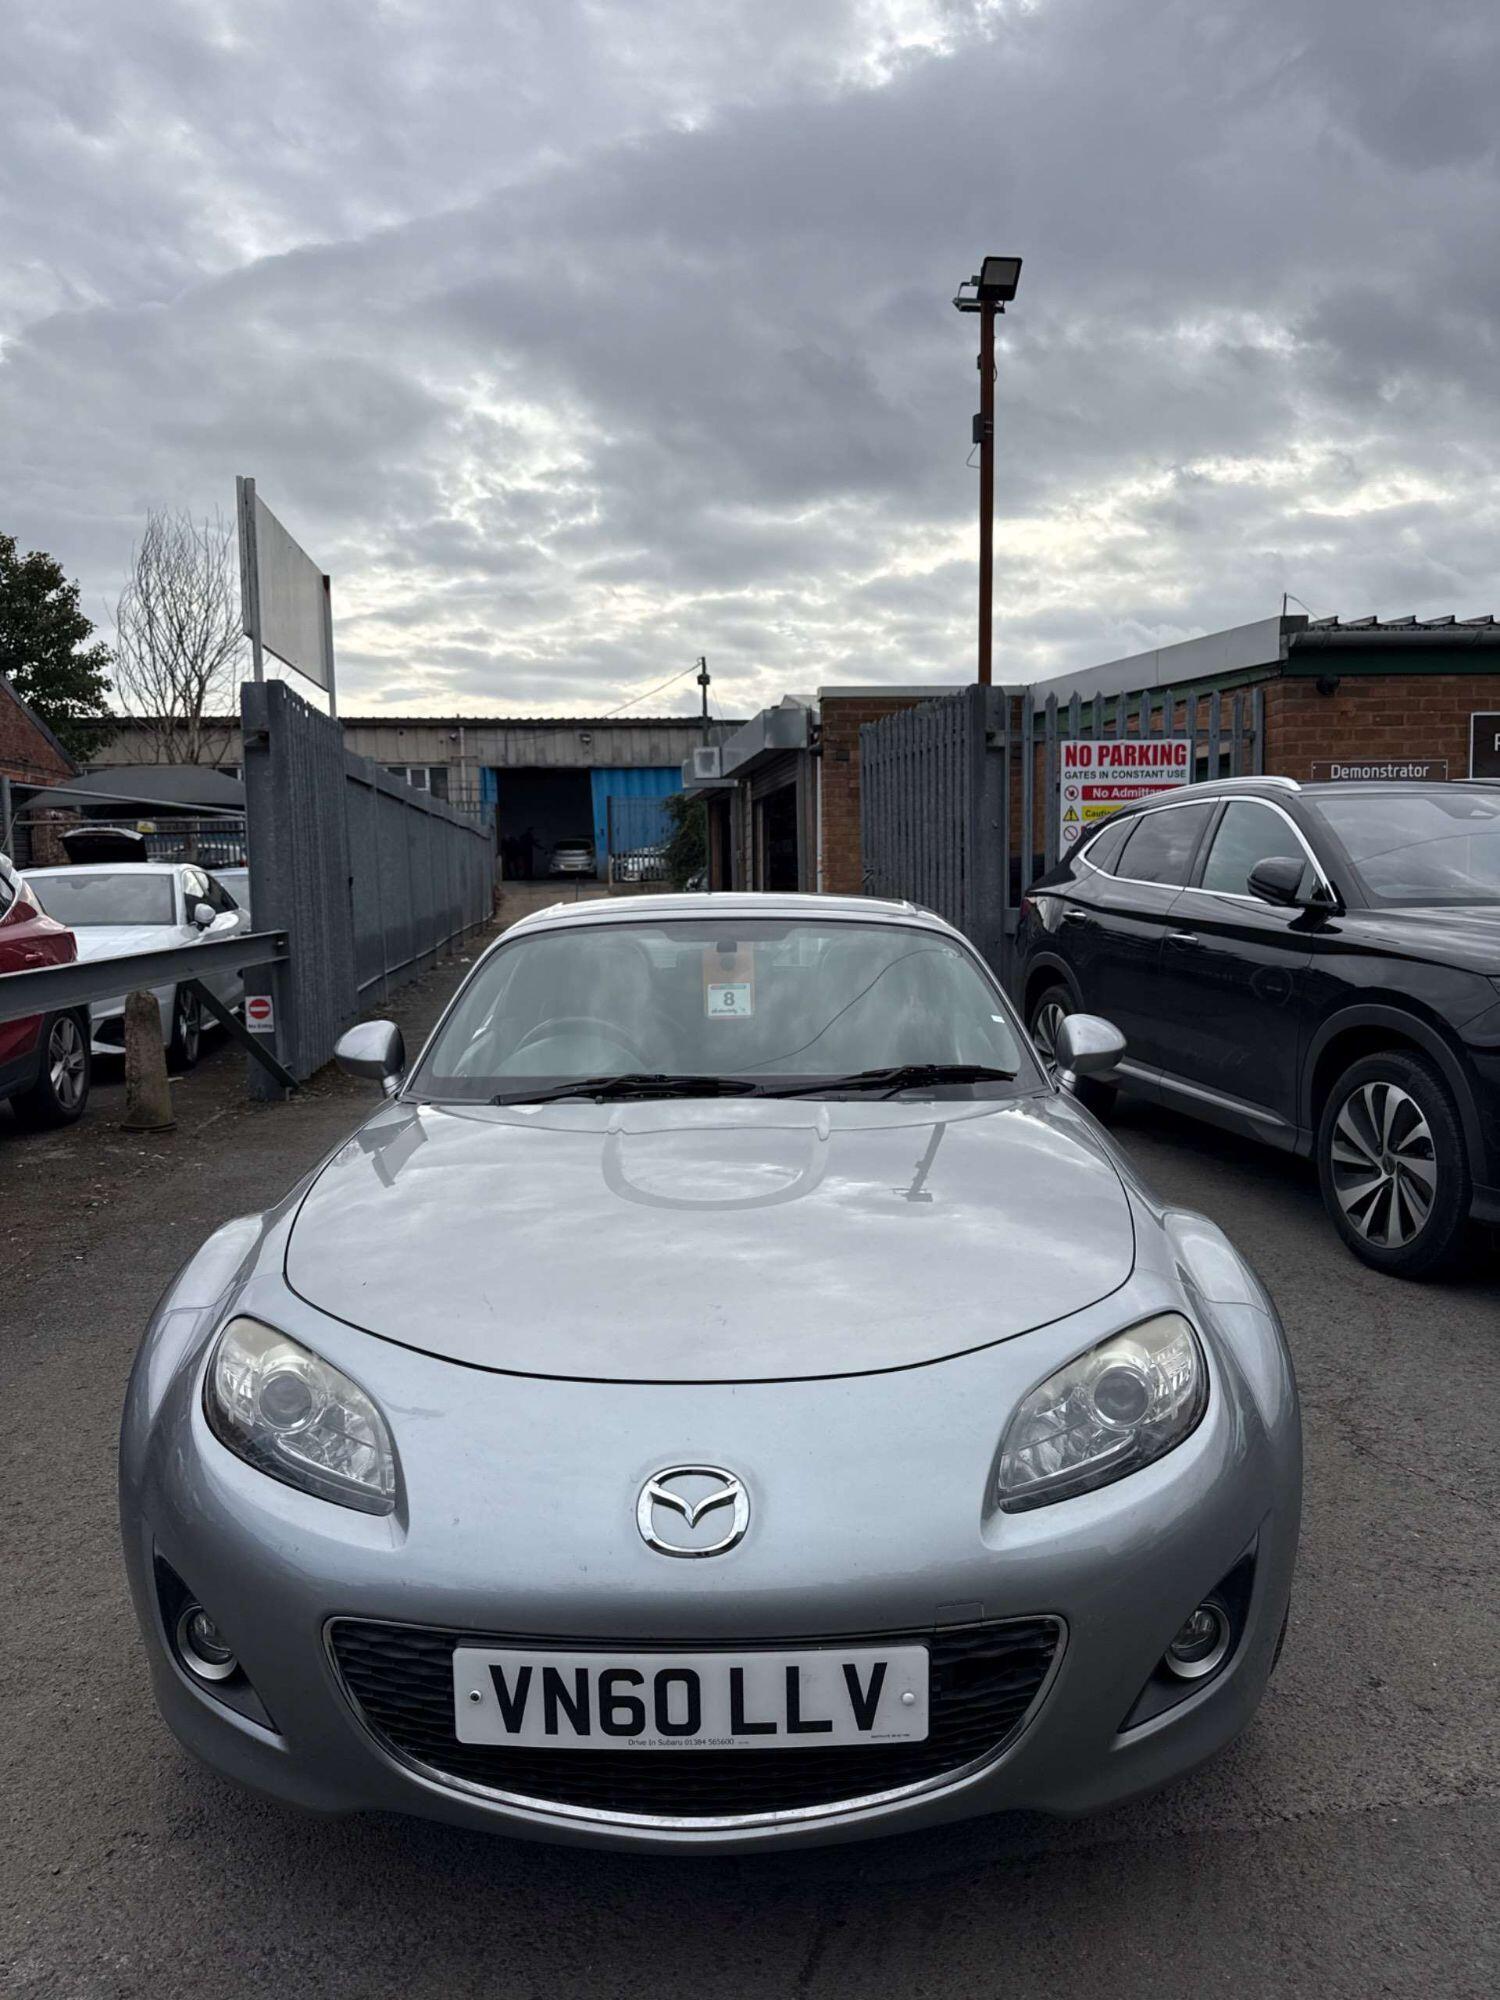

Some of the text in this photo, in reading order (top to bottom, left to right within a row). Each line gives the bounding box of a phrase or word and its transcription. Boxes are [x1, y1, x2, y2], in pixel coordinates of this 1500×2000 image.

[1065, 744, 1187, 767] NO PARKING
[1064, 769, 1187, 780] GATES IN CONSTANT USE
[1331, 763, 1430, 779] Demonstrator
[1092, 788, 1109, 798] No
[723, 991, 735, 1007] 8
[489, 1662, 888, 1736] VN60 LLV
